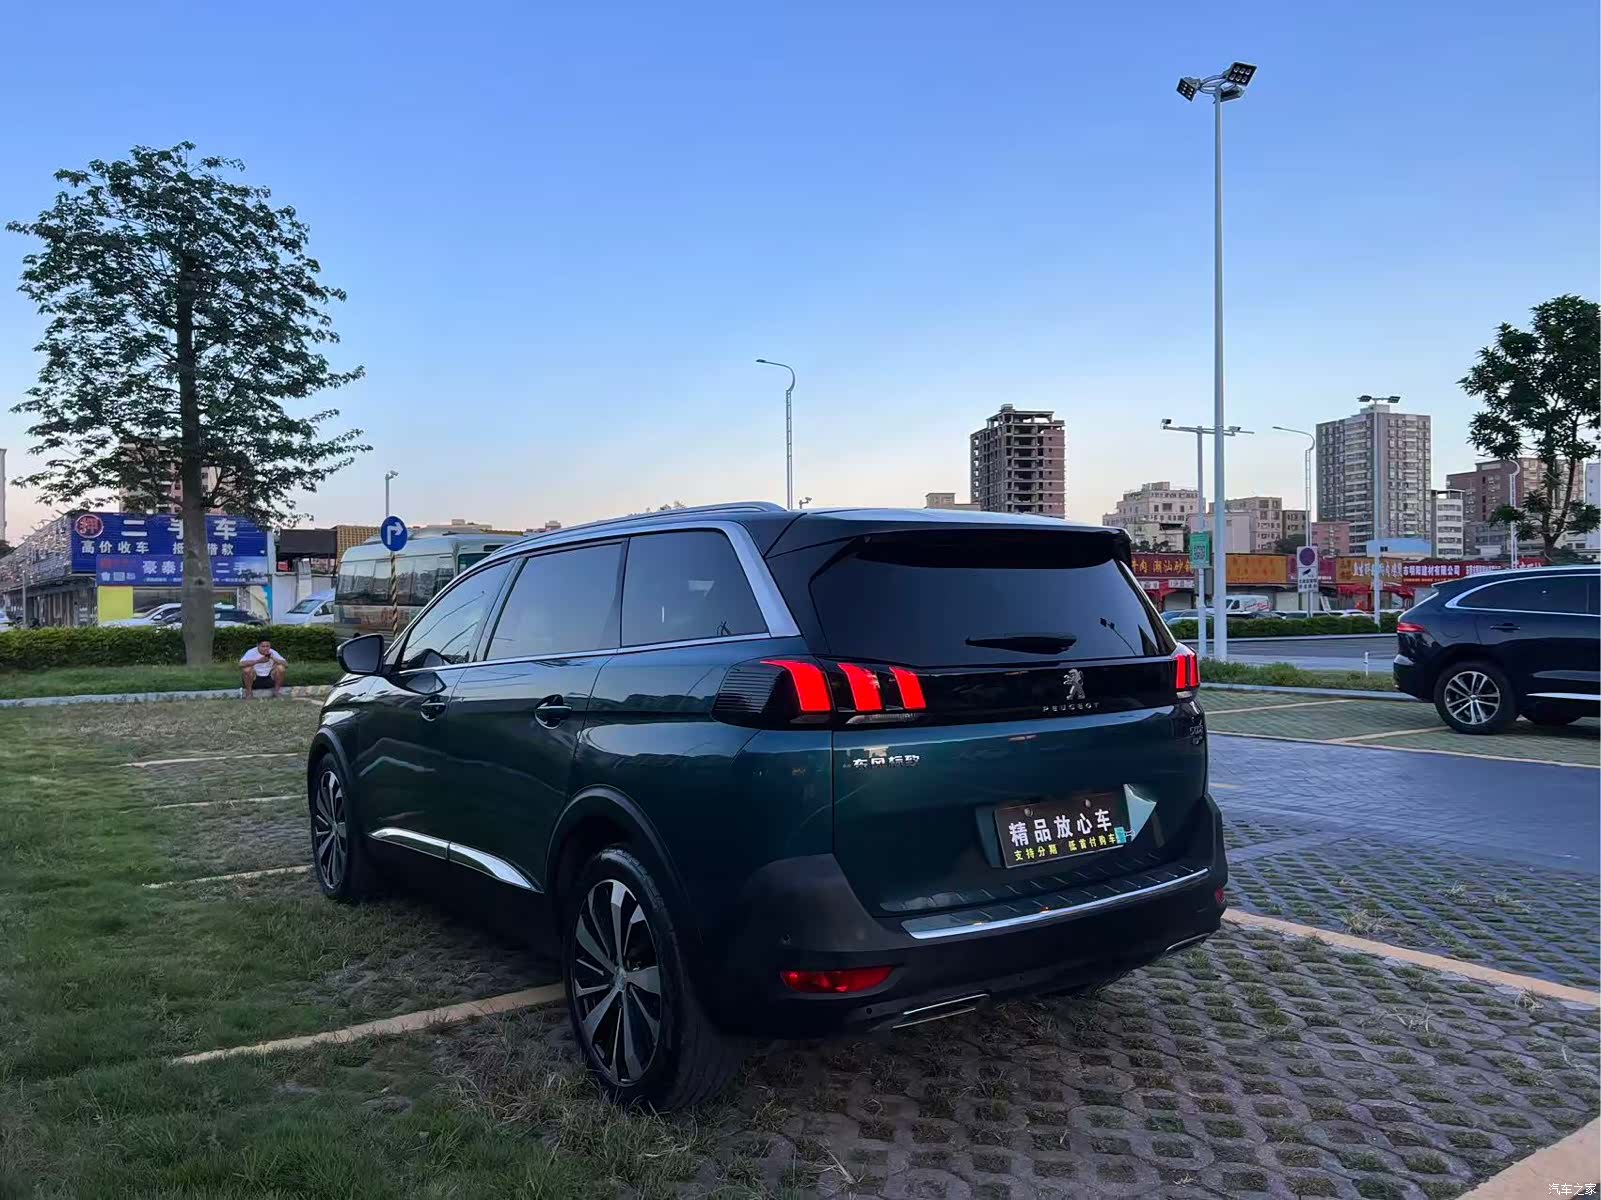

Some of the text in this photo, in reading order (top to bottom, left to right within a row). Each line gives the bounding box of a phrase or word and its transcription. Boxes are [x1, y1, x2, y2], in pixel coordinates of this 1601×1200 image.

[120, 518, 238, 540] 二手车
[81, 540, 150, 554] 高价收车
[172, 541, 234, 555] 抵借款
[1042, 702, 1100, 712] PEUGEOT
[852, 754, 920, 769] 东风标致
[1008, 808, 1113, 847] 精品放心车
[1014, 844, 1058, 862] 支持分期
[1068, 833, 1117, 852] 低首付购车
